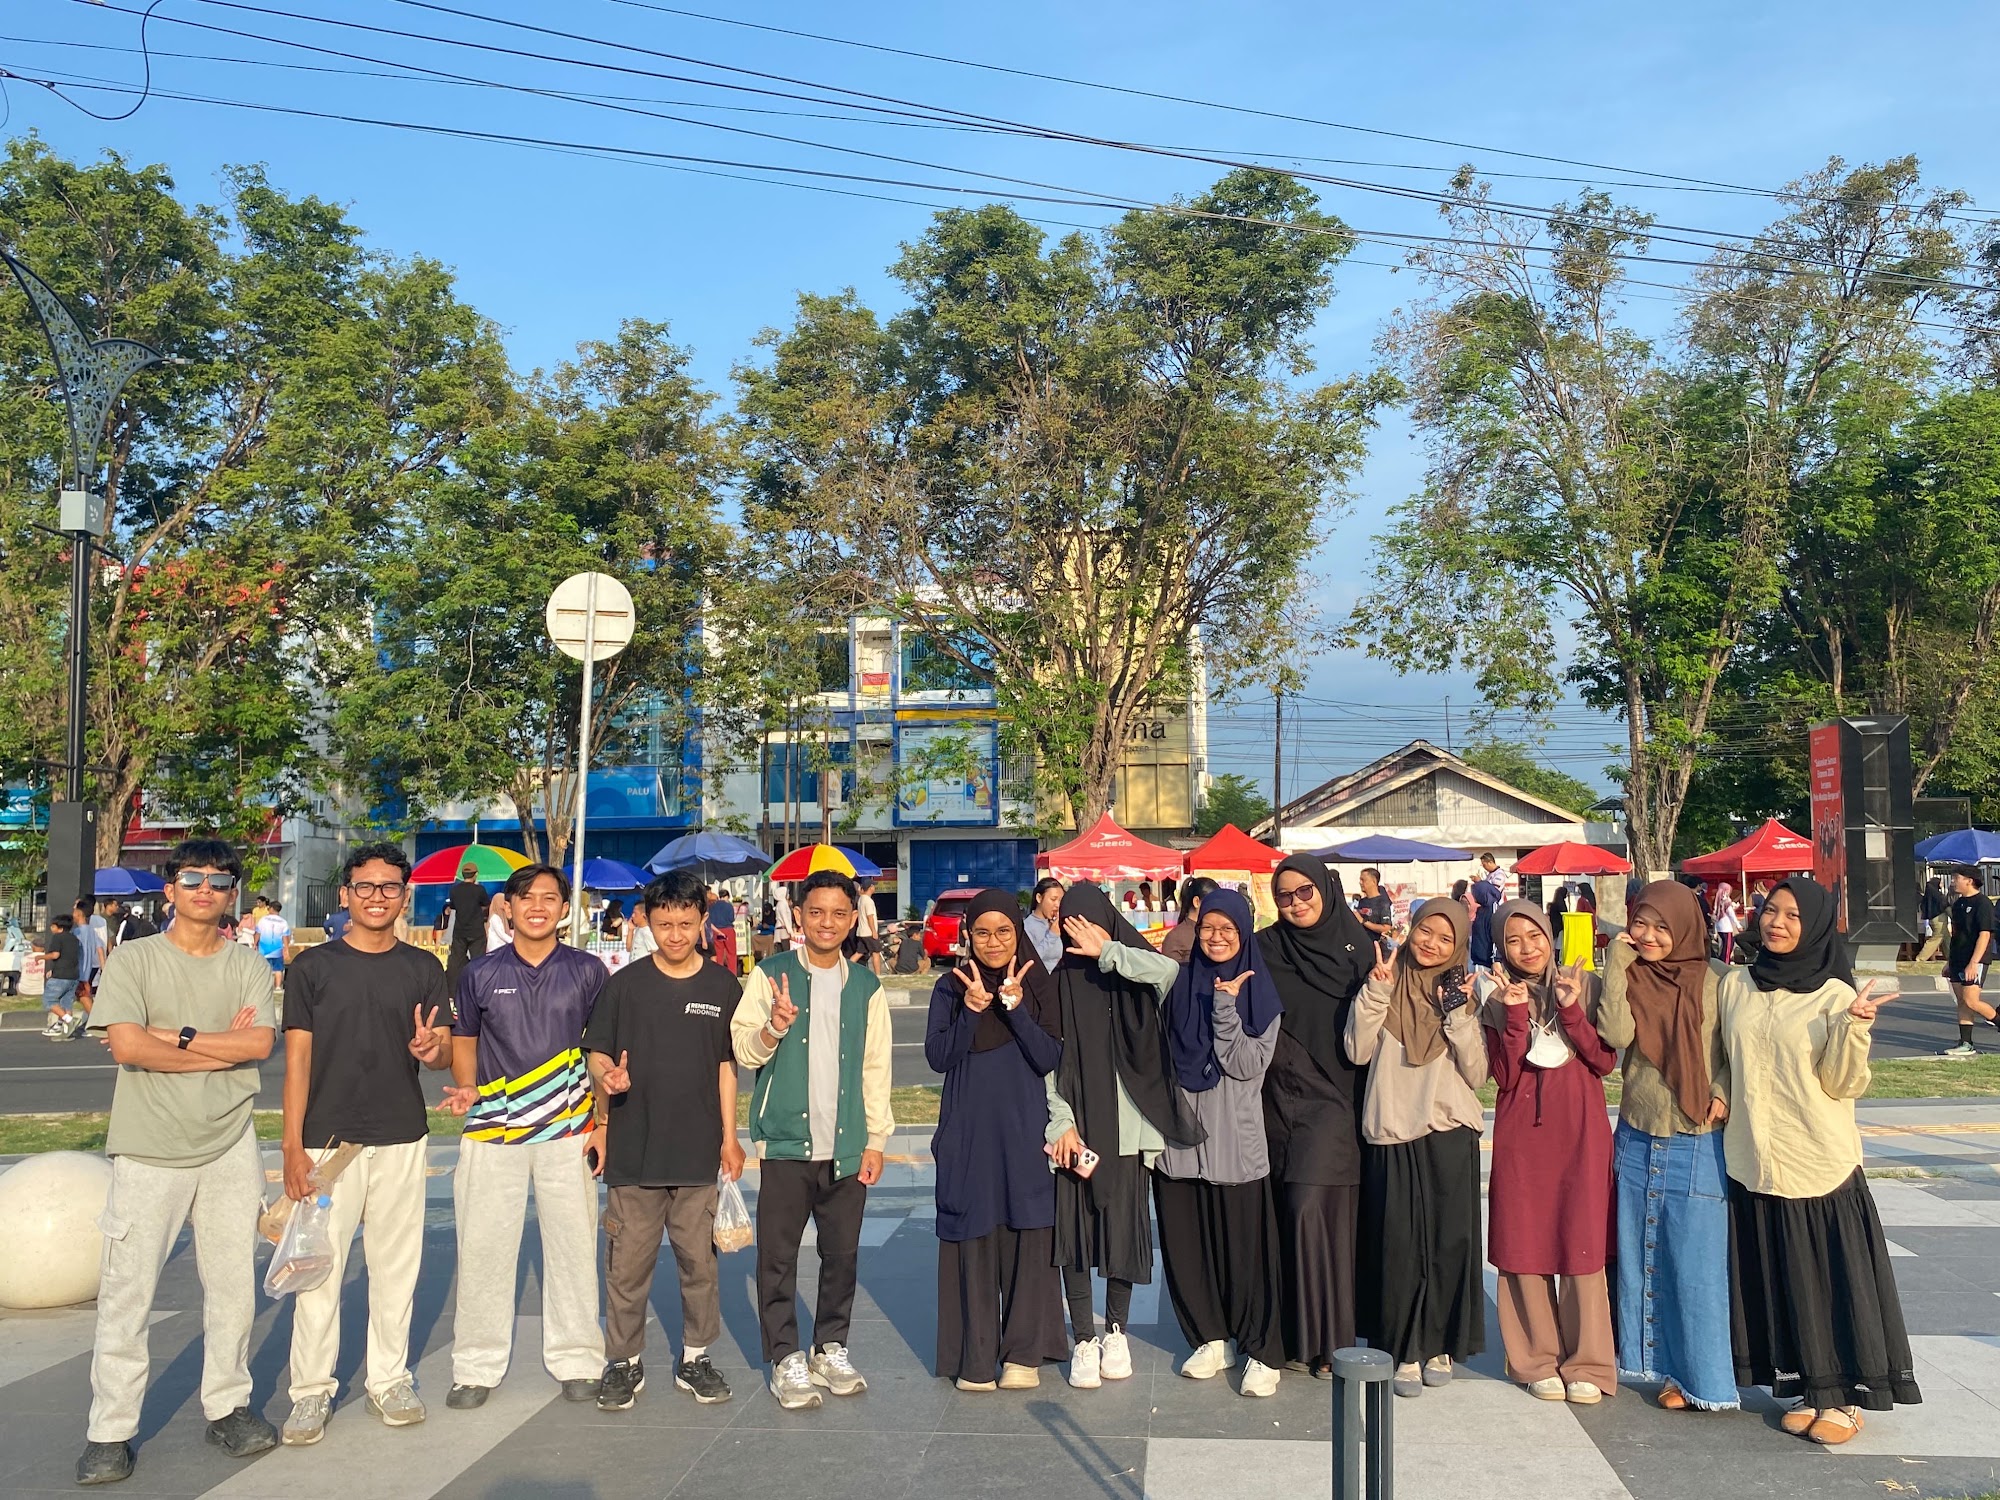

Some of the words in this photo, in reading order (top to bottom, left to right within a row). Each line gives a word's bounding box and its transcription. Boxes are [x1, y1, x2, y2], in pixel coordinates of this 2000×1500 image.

[626, 787, 650, 796] PALU
[1089, 840, 1133, 848] speeds
[1772, 842, 1811, 850] speeds
